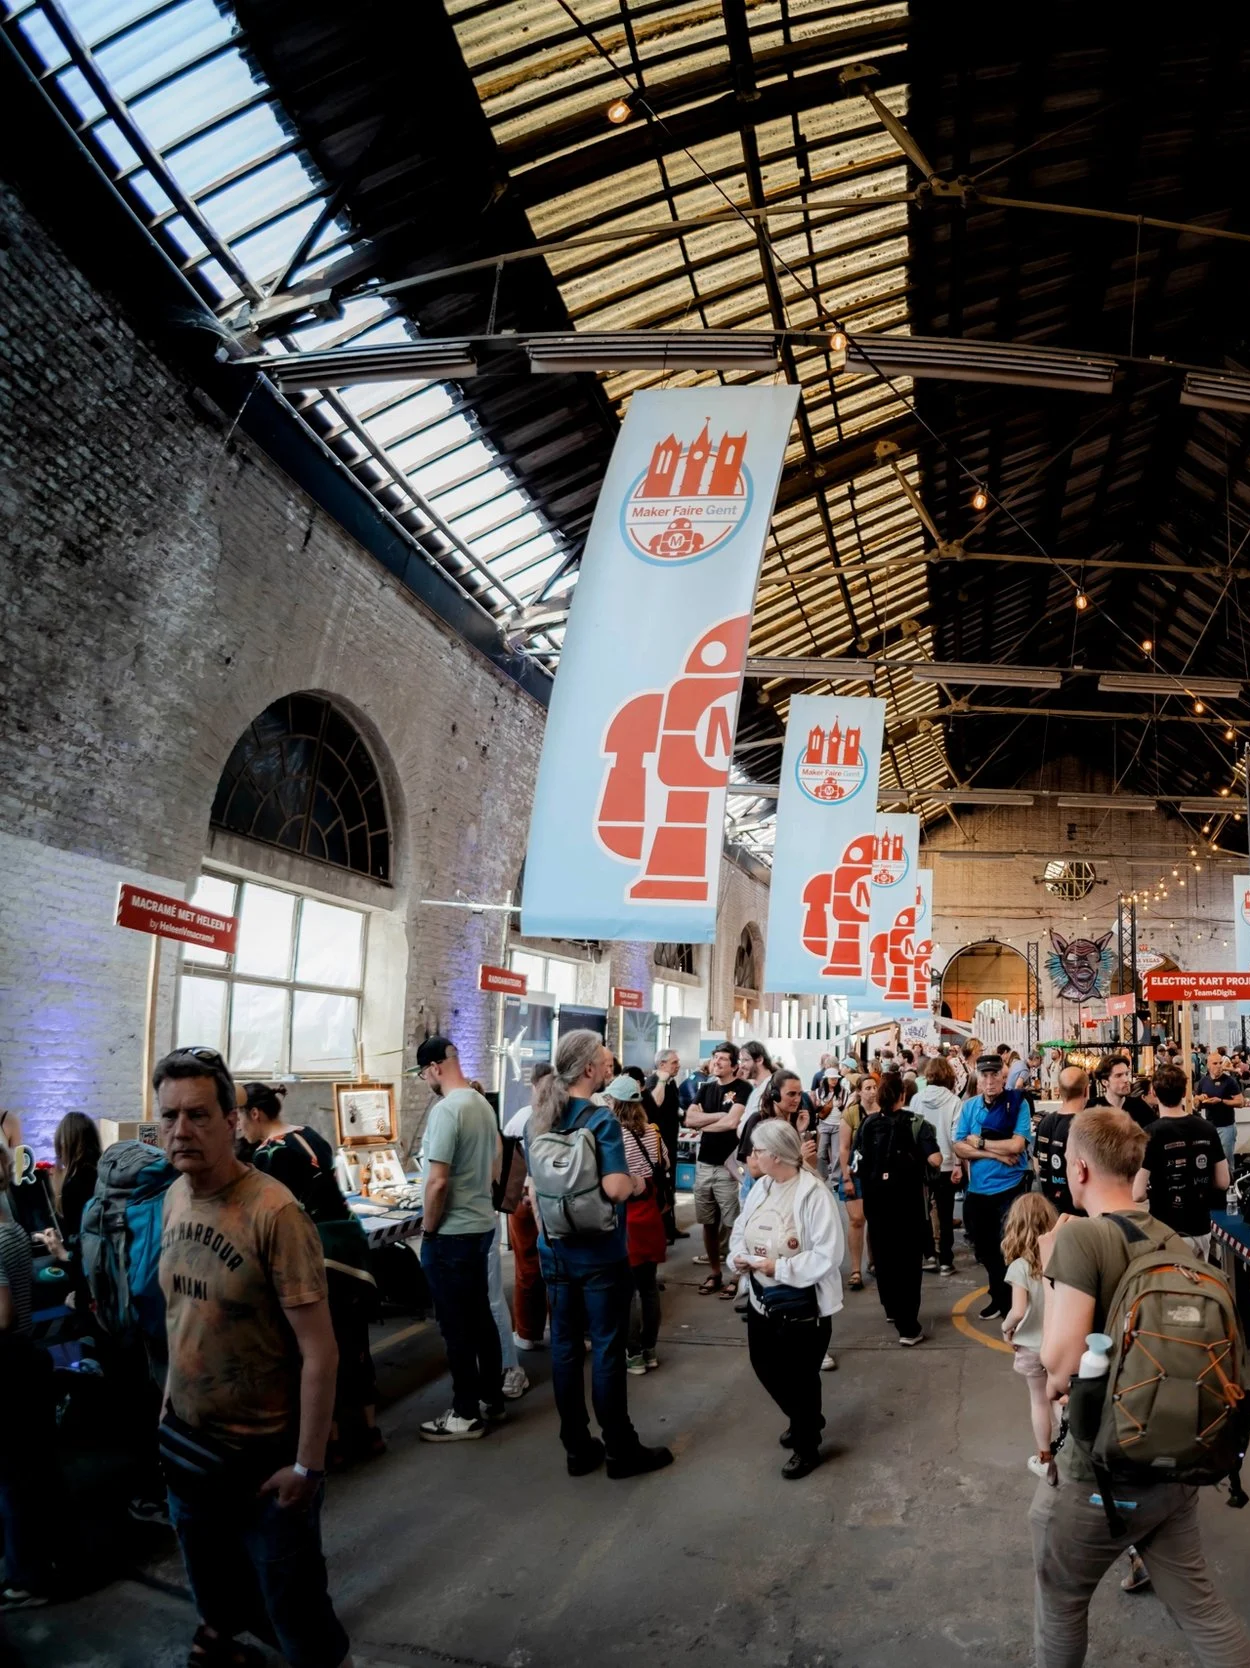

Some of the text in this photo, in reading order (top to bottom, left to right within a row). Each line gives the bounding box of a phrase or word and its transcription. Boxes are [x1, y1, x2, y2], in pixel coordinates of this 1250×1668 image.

[632, 505, 738, 517] Maker Faire Gent
[670, 536, 683, 546] M
[131, 895, 233, 933] MACRAMÉ MET HELEEN V
[149, 919, 159, 930] by
[1151, 977, 1197, 986] ELECTRIC
[1199, 977, 1224, 986] KART
[1184, 989, 1237, 998] by Team4Digits
[178, 1222, 244, 1272] HARBOUR
[173, 1273, 207, 1301] MIAMI
